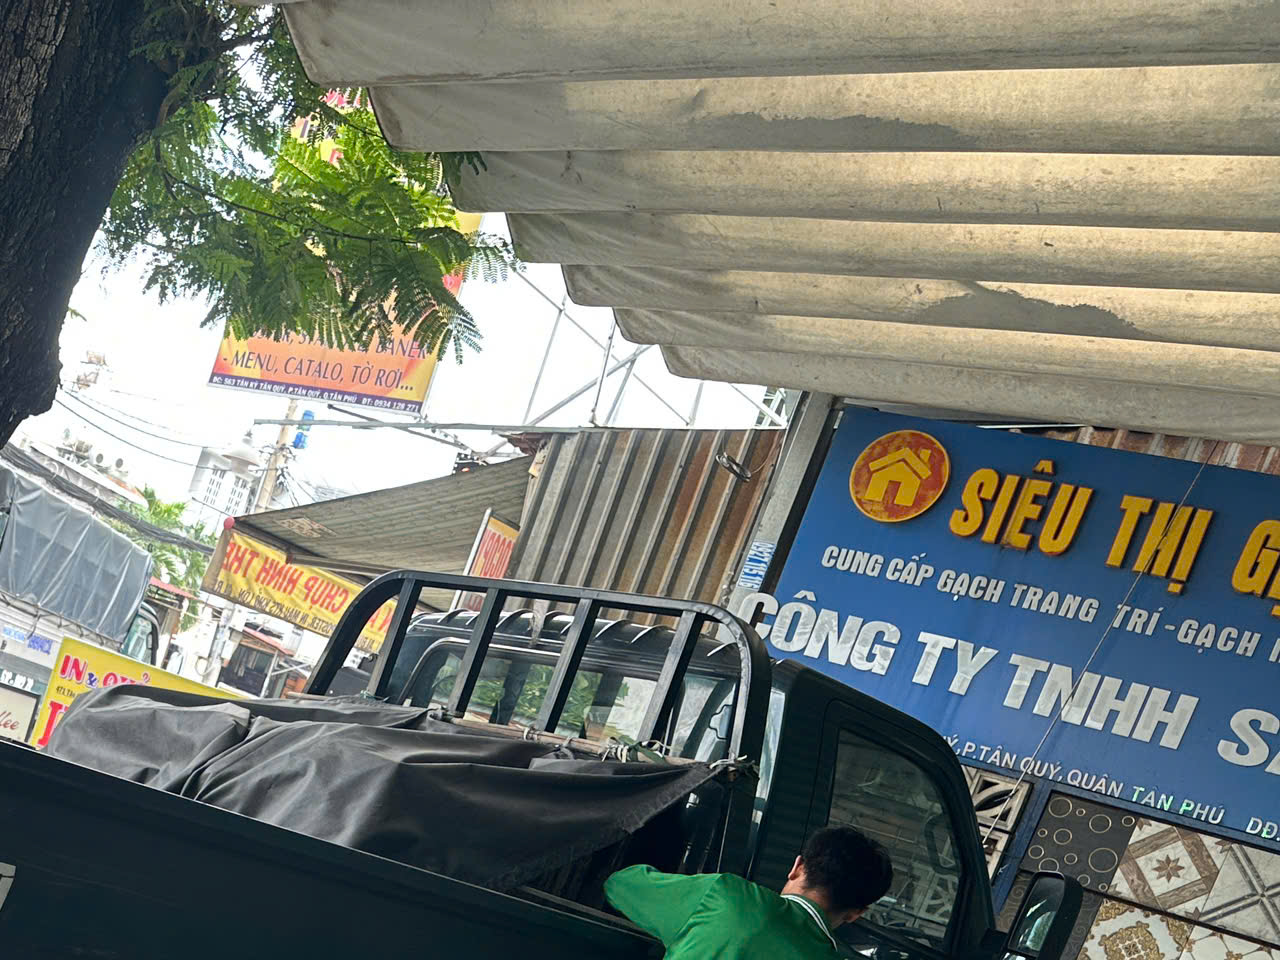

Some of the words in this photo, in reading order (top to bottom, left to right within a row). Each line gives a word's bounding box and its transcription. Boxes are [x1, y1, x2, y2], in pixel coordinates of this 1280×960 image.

[231, 350, 278, 375] MENU,
[283, 357, 345, 384] CATALO,
[948, 458, 1094, 557] SIÊU
[1105, 493, 1214, 595] THỊ
[1231, 520, 1280, 617] G
[821, 545, 884, 580] CUNG
[886, 548, 934, 588] CẤP
[937, 571, 1006, 604] GẠCH
[1012, 582, 1101, 624] TRANG
[1112, 603, 1164, 637] TRÍ
[59, 655, 87, 685] IN
[741, 588, 902, 676] CÔNG
[911, 631, 1000, 697] TY
[1002, 653, 1200, 751] TNHH
[1217, 708, 1280, 776] S
[1131, 785, 1174, 812] TÂN
[1179, 798, 1226, 825] PHÚ
